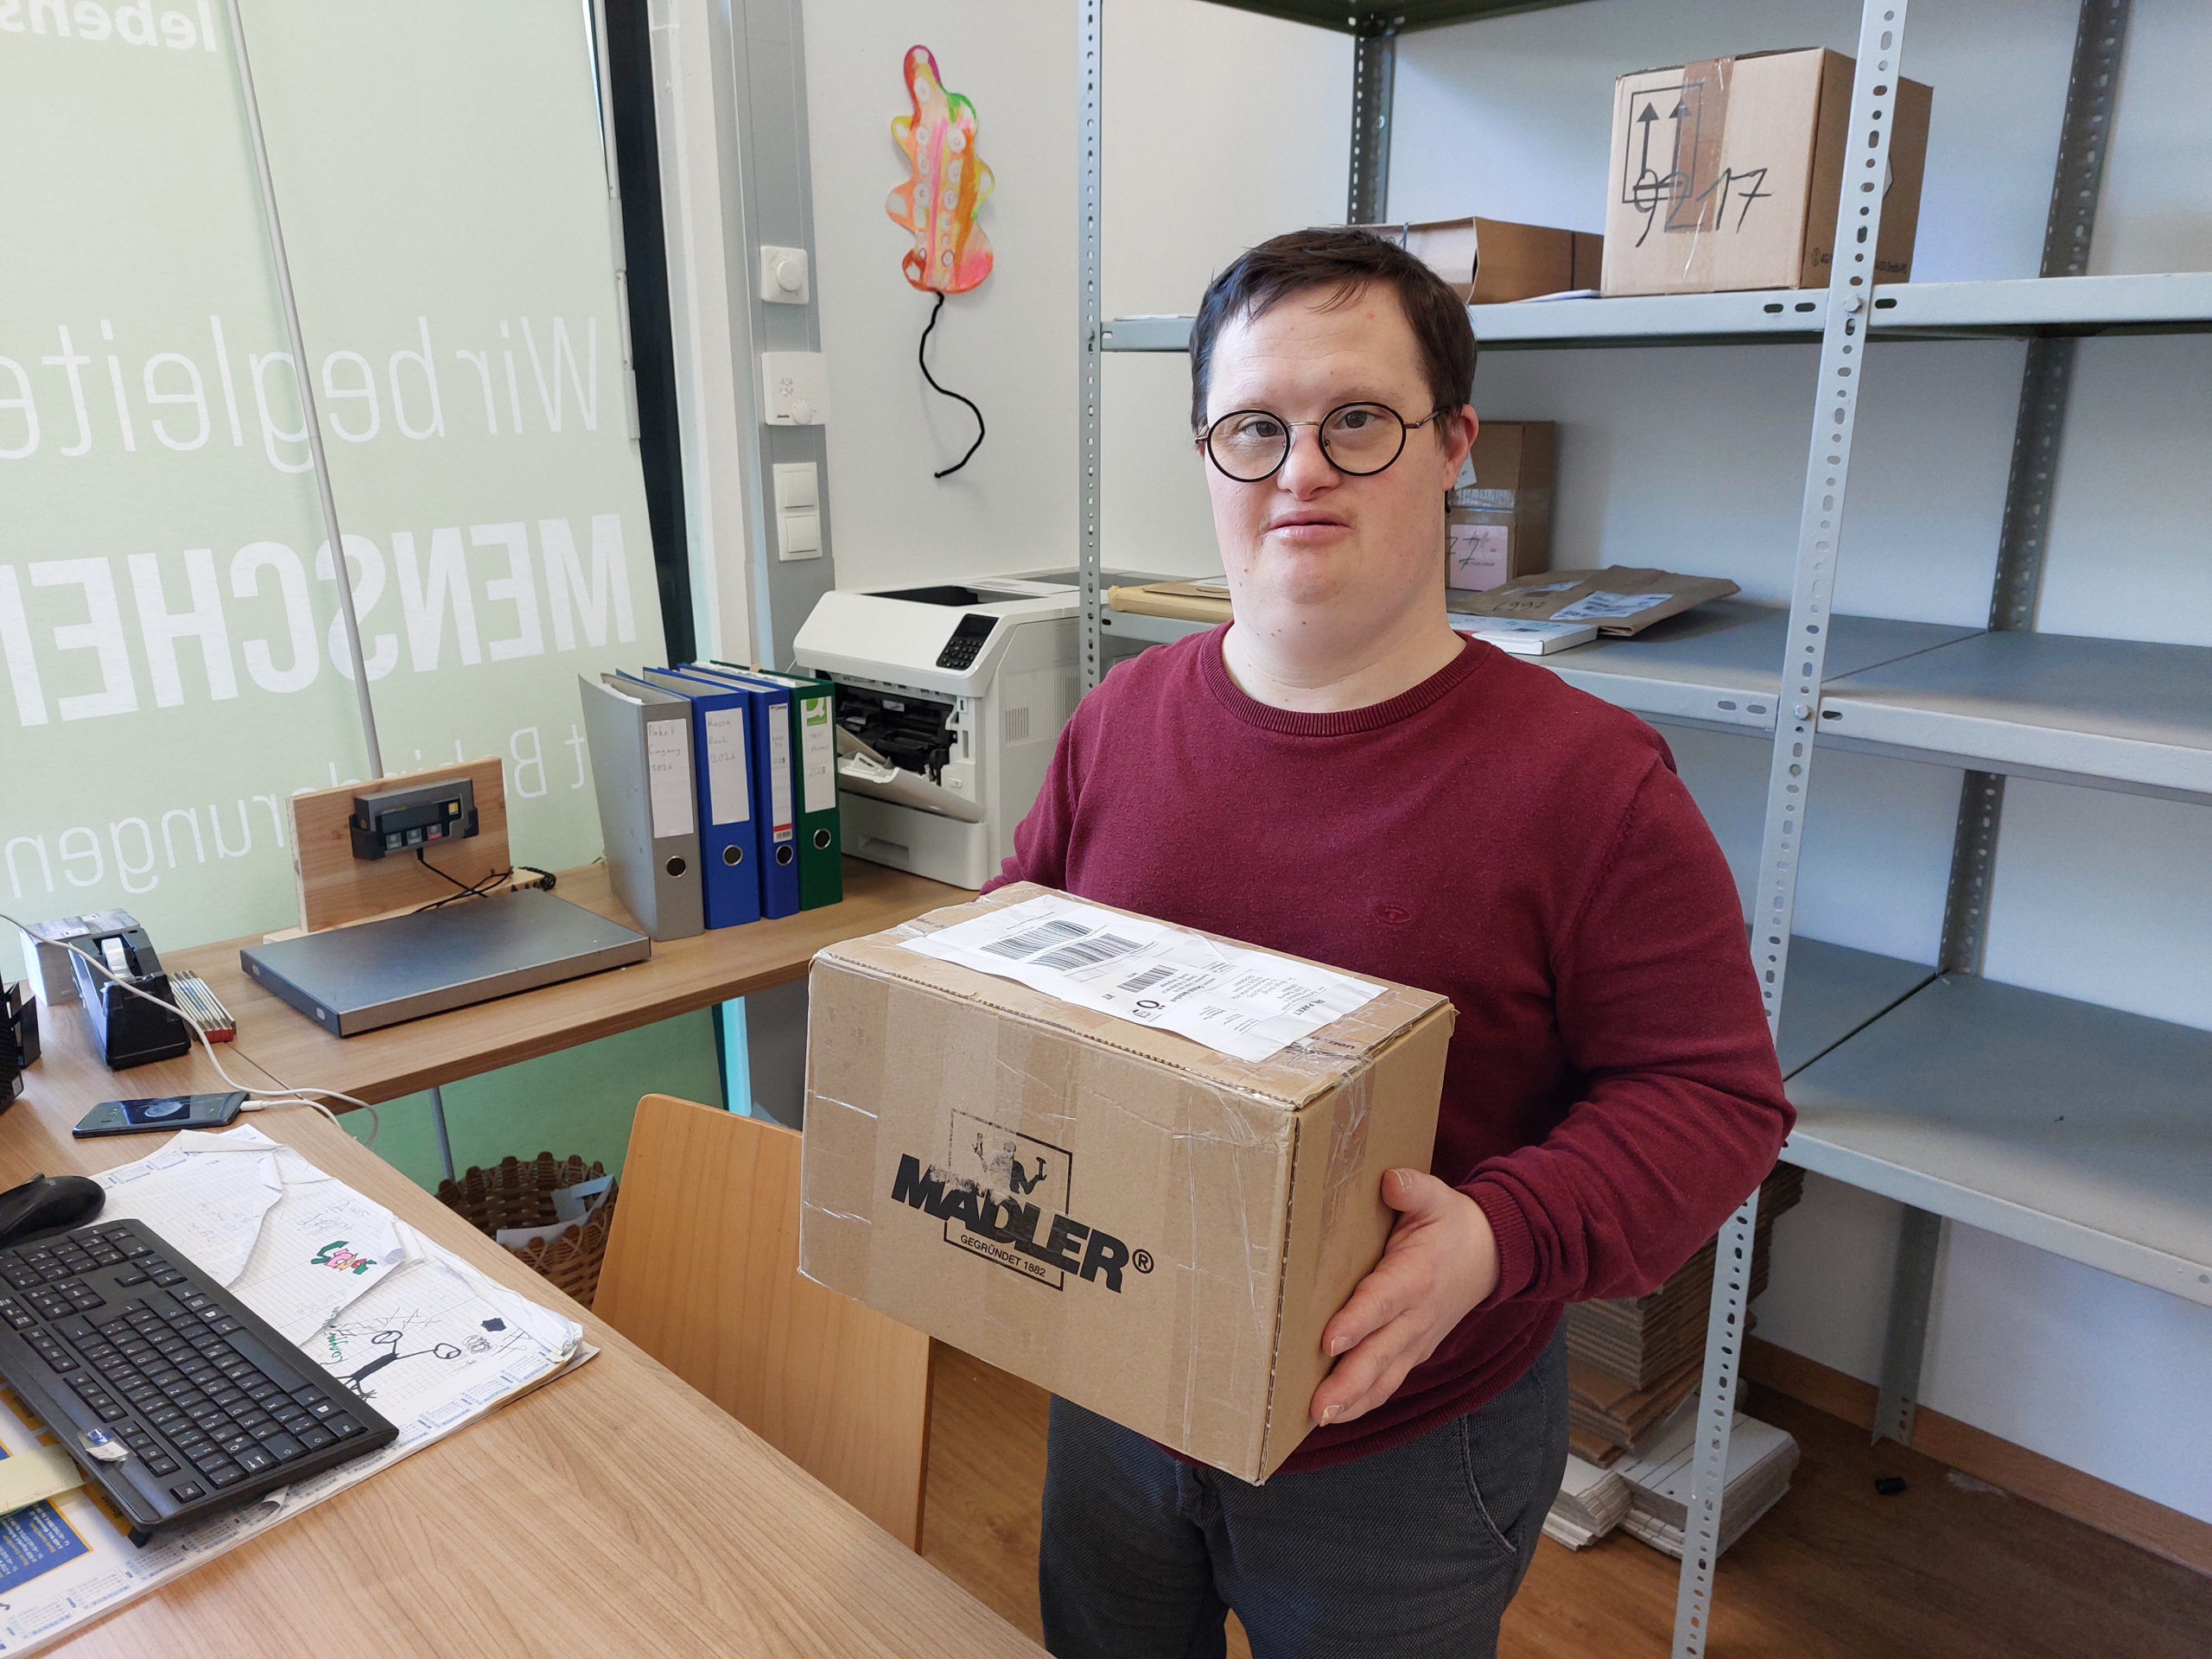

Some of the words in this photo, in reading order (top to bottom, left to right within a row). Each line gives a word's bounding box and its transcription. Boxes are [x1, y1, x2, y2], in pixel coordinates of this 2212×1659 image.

[648, 724, 677, 738] Paket
[960, 1234, 1022, 1268] GEGRÜNDET
[1023, 1260, 1047, 1278] 1882
